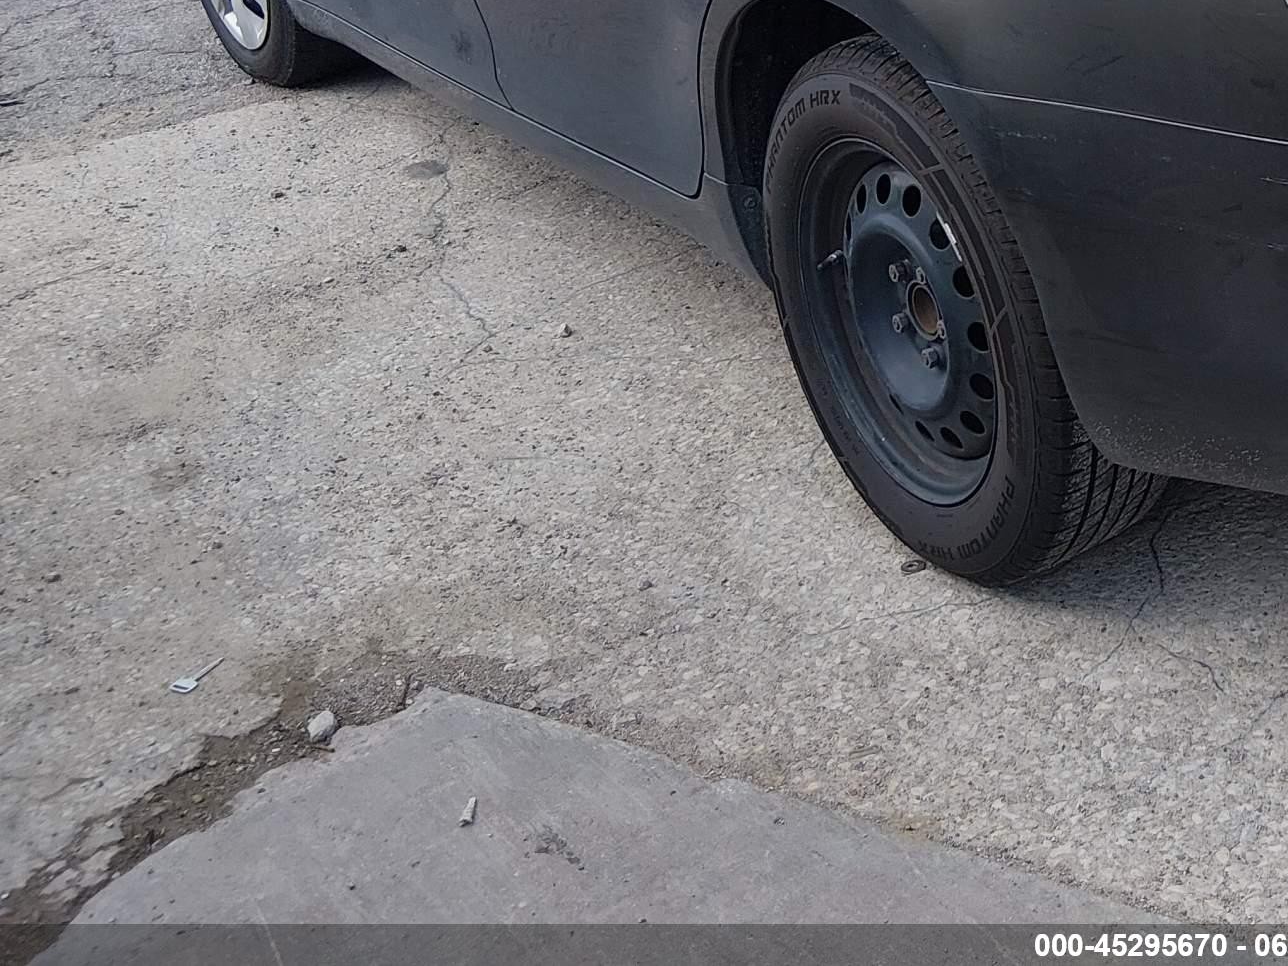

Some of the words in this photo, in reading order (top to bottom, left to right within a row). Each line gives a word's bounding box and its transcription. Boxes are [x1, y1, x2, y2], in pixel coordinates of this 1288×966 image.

[765, 97, 806, 194] PHANTOM
[809, 89, 841, 109] HRX
[956, 475, 1016, 559] PHANTOM
